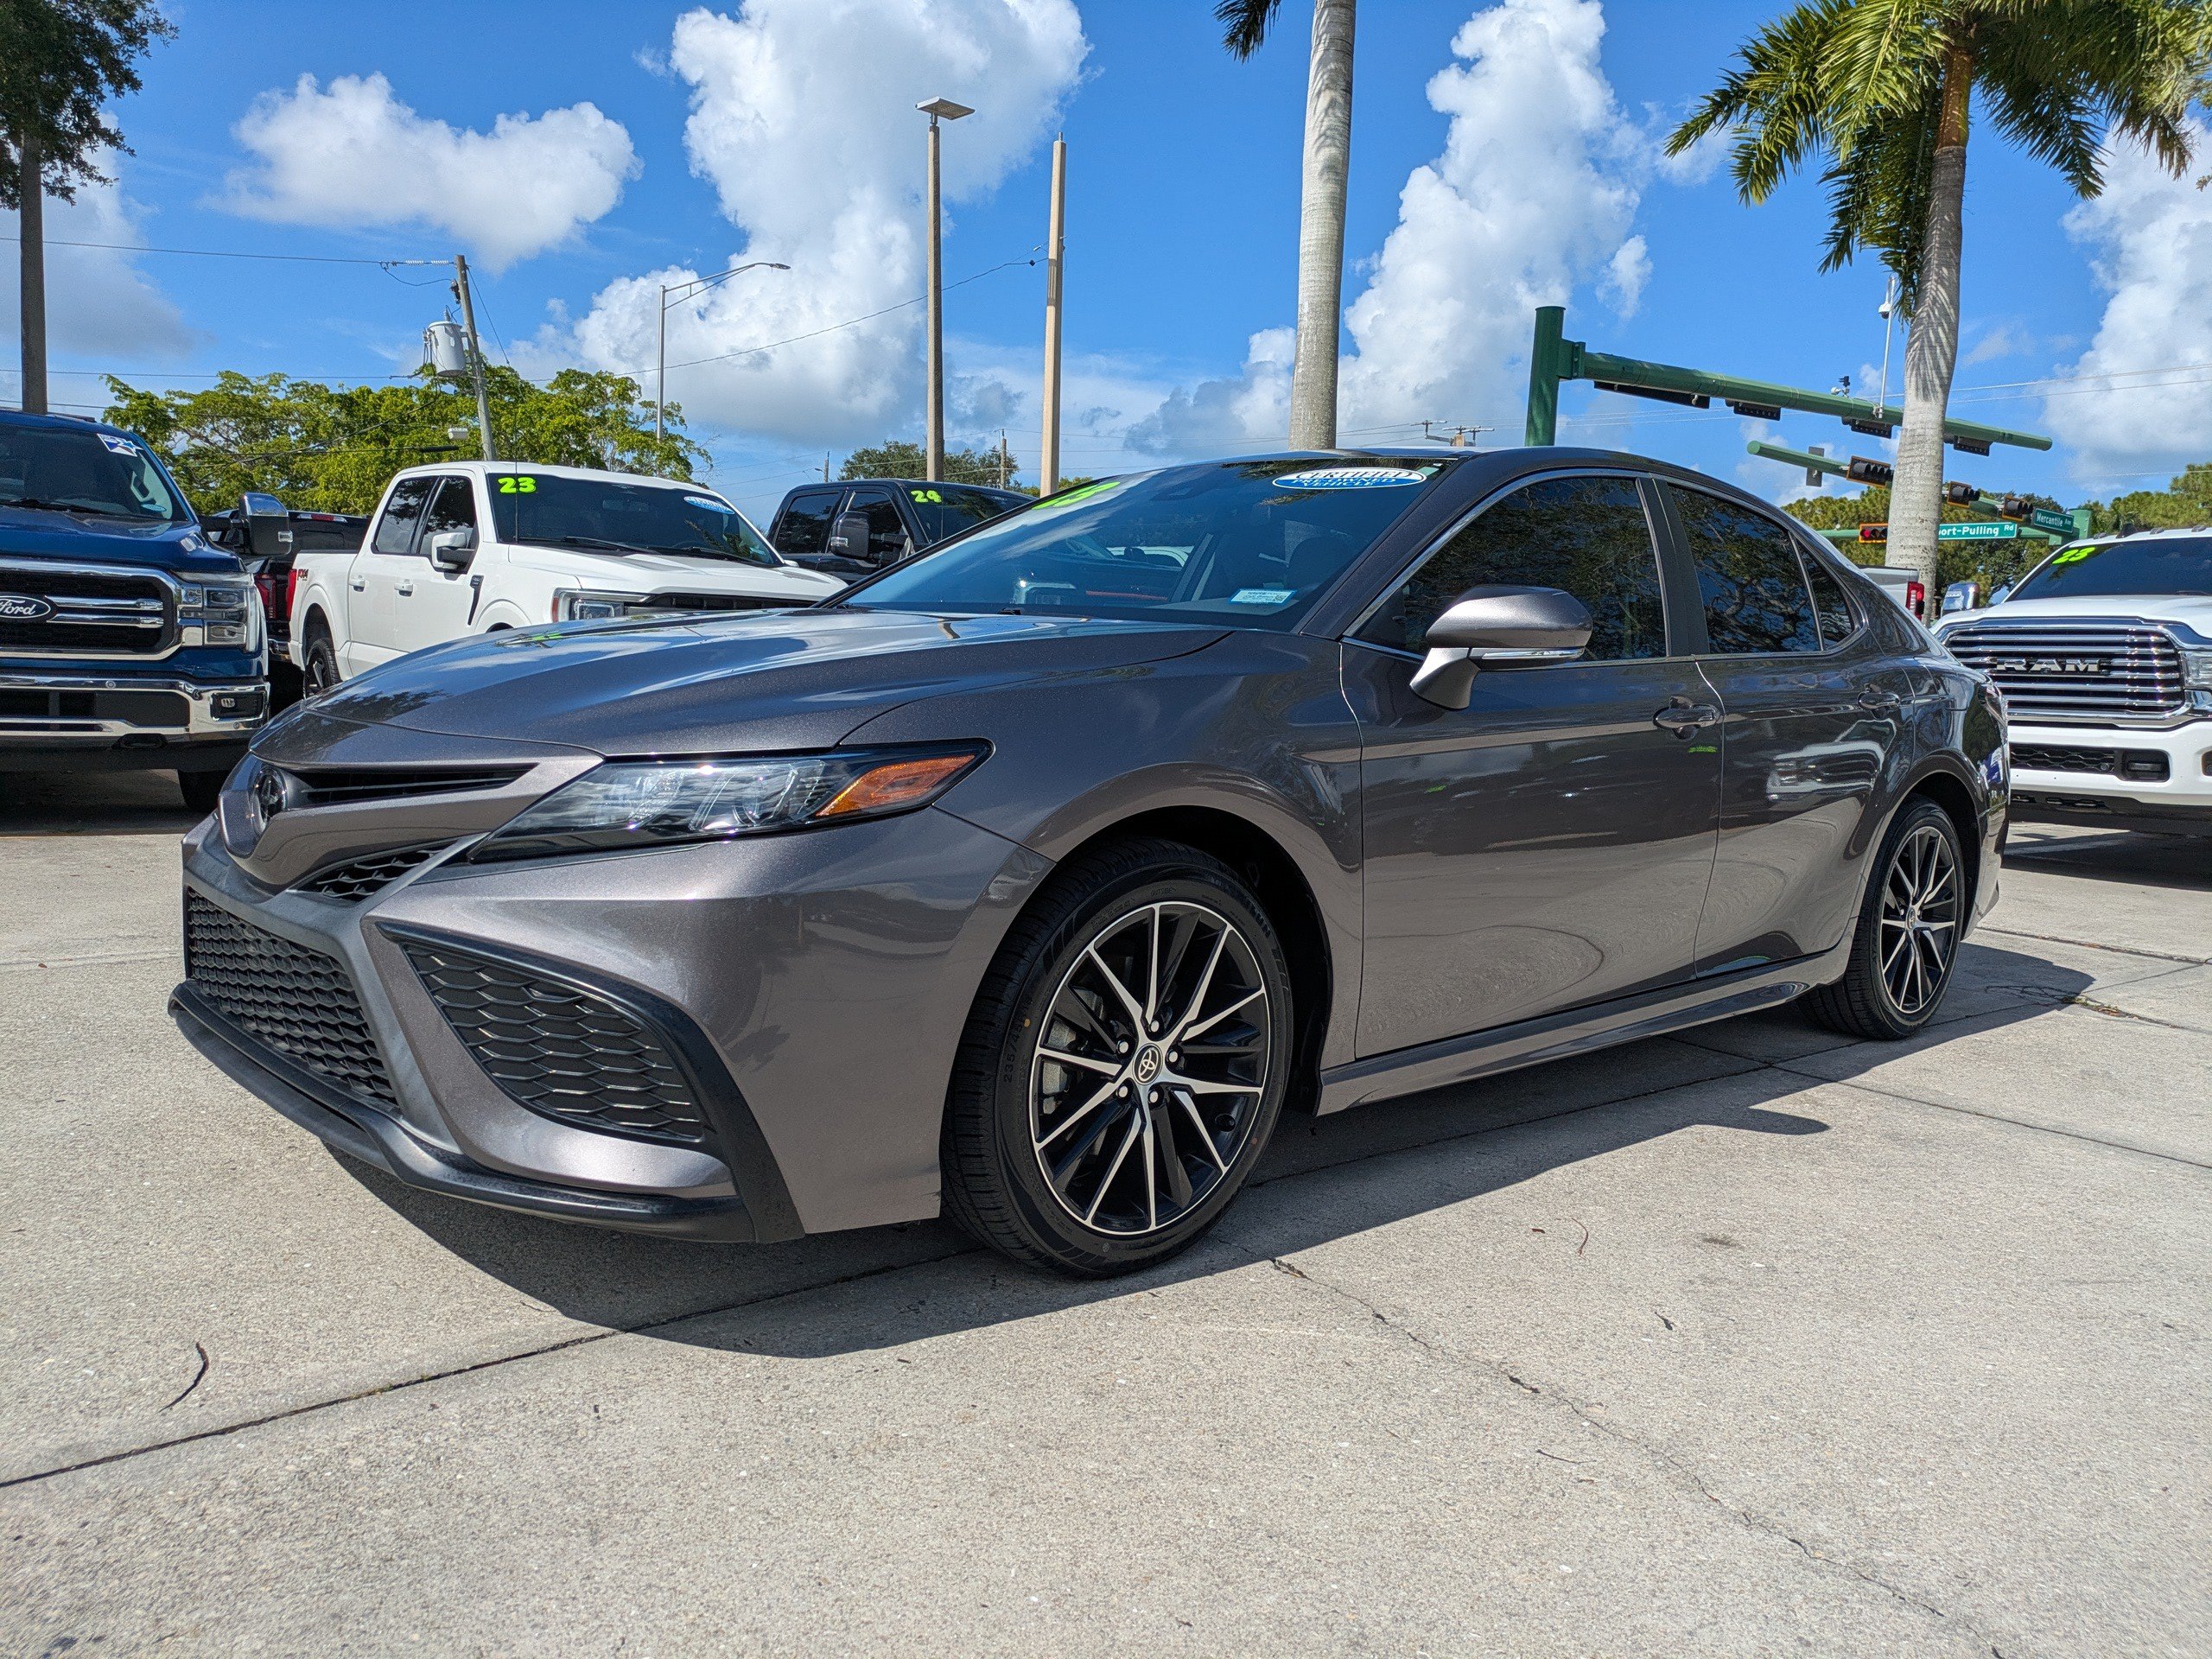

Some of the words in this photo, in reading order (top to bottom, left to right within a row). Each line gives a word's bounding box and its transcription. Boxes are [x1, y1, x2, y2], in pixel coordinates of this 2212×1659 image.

[498, 477, 537, 493] 23
[911, 490, 943, 503] 24
[2036, 512, 2063, 527] Mercantile
[1938, 525, 1999, 537] ort-Pulling
[2051, 547, 2095, 564] 23
[0, 599, 37, 615] Ford
[1996, 658, 2100, 672] RAM
